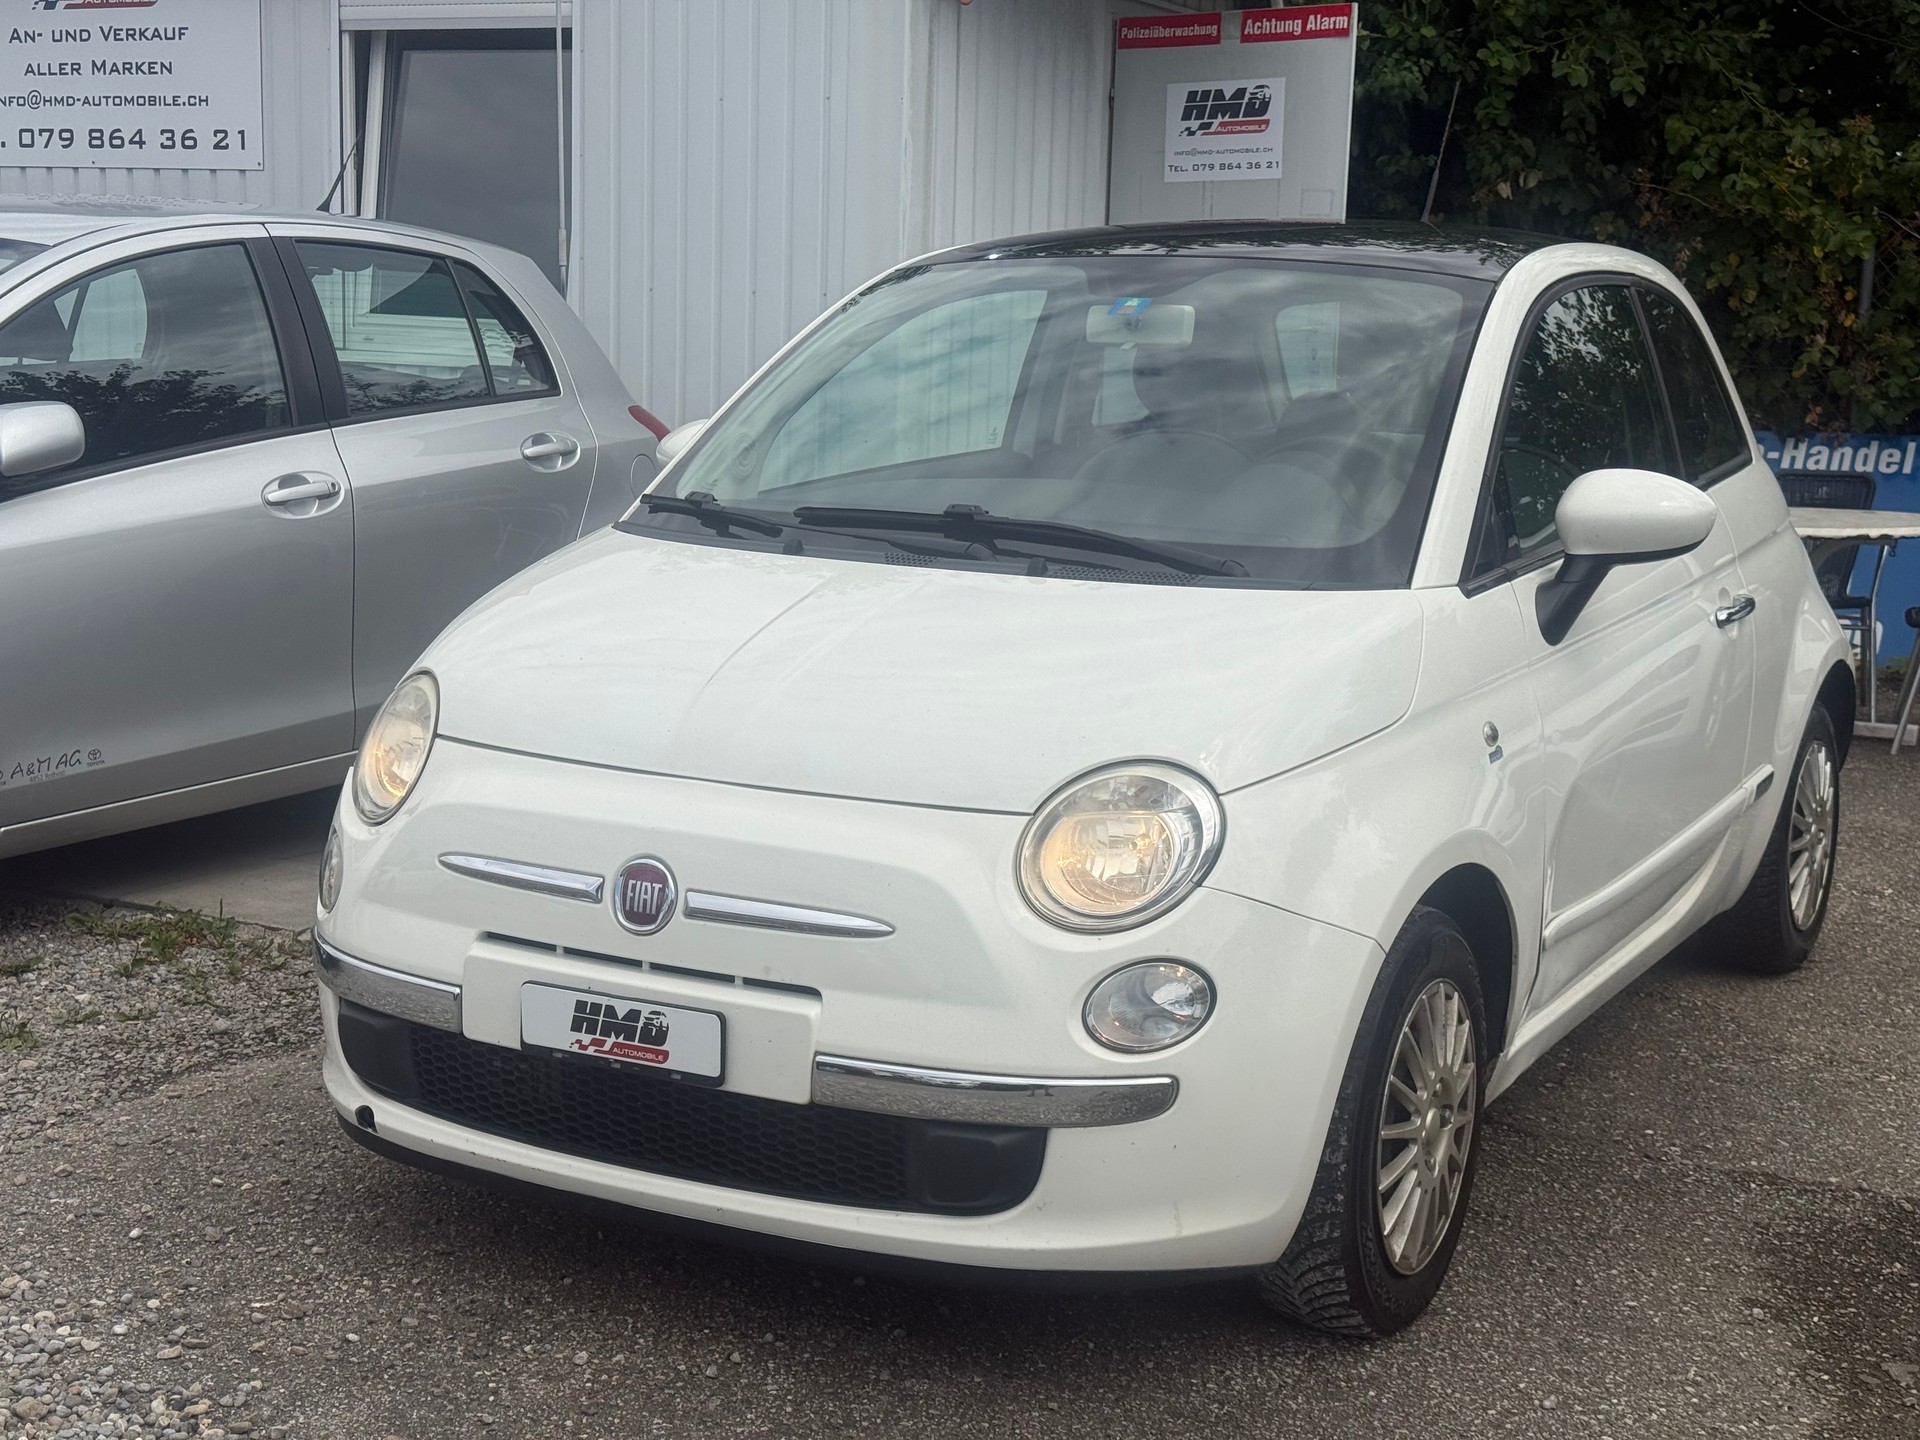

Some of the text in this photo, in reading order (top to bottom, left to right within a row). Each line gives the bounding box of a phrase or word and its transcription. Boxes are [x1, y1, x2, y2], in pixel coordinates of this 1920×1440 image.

[1121, 23, 1218, 39] Polizeiüberwachung
[1244, 14, 1348, 36] Achtung Alarm
[1181, 85, 1272, 121] HMD
[18, 128, 75, 149] 079
[88, 128, 146, 149] 864
[160, 128, 198, 150] 36
[212, 129, 246, 150] 21
[1216, 123, 1267, 133] AUTOMOBILE
[1192, 163, 1215, 172] 079
[1219, 162, 1242, 170] 864
[1246, 161, 1261, 170] 36
[1266, 161, 1280, 169] 21
[1757, 437, 1917, 474] -Handel
[10, 756, 51, 780] A&M
[55, 749, 82, 770] AG
[626, 879, 663, 915] FIAT
[570, 999, 670, 1047] HMD
[612, 1046, 664, 1062] AUTOMOBILE
